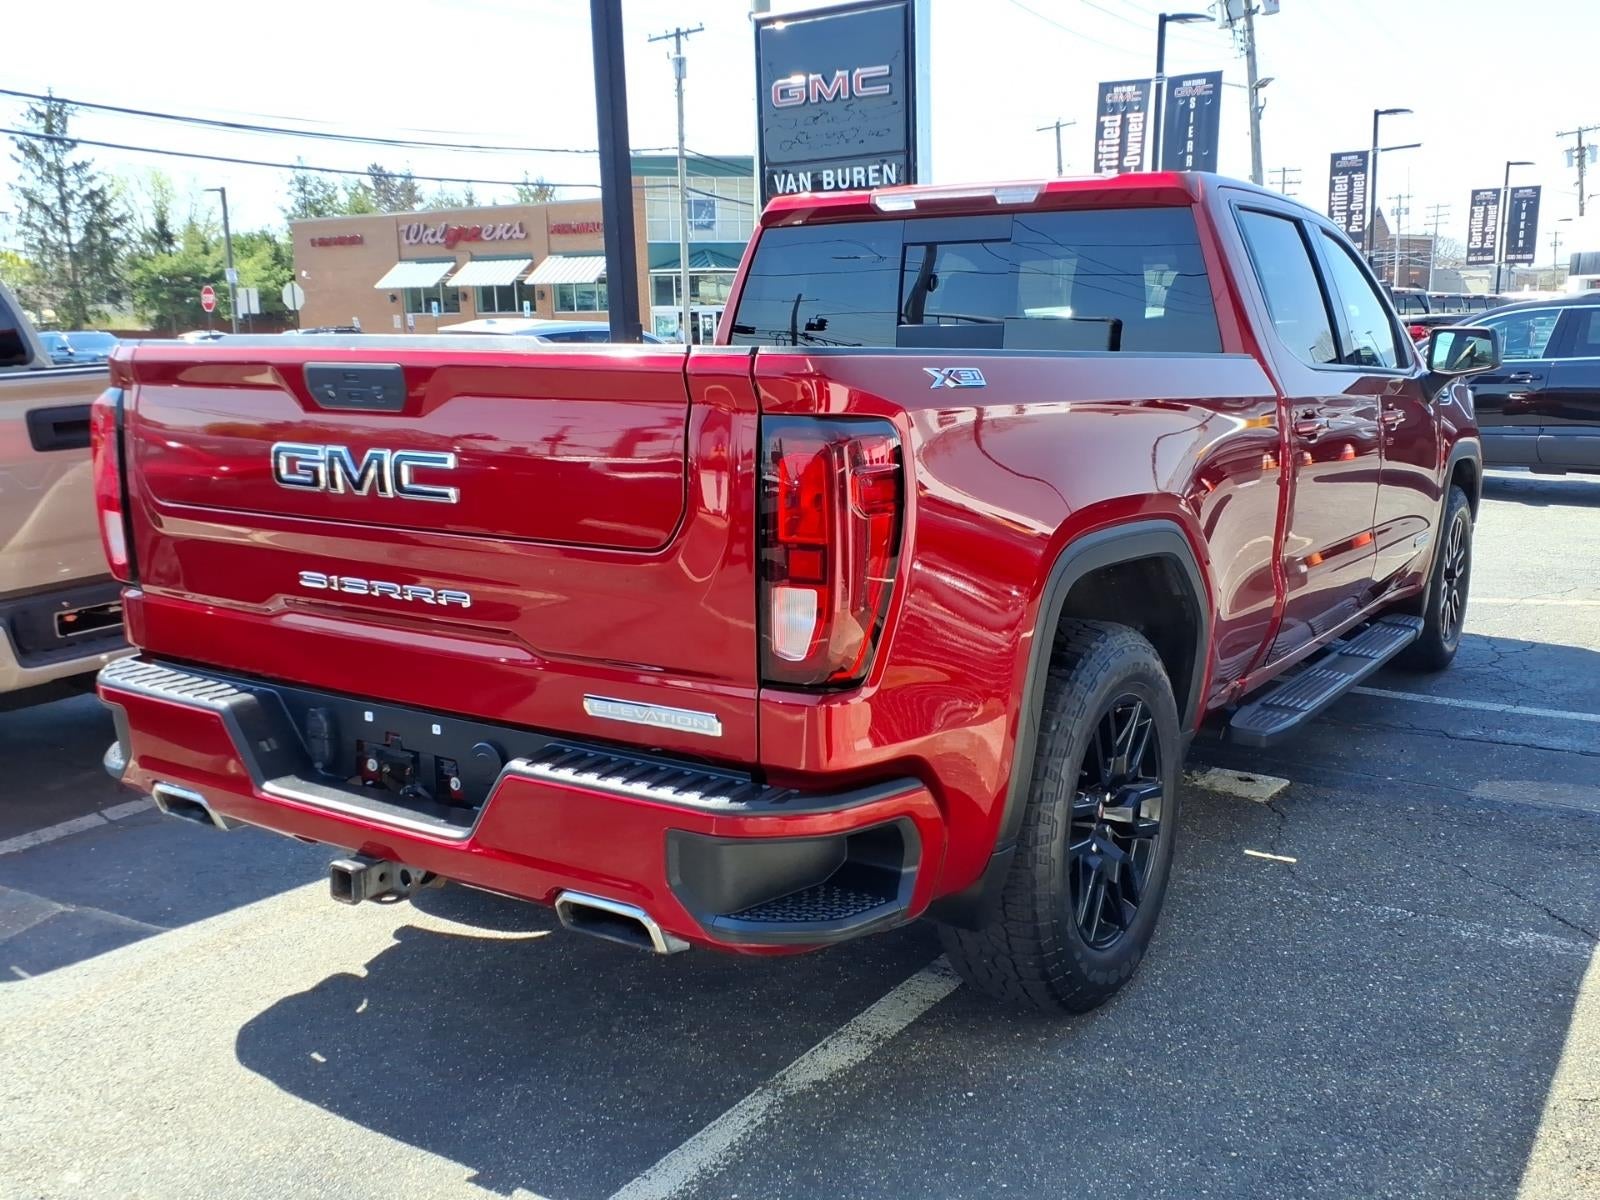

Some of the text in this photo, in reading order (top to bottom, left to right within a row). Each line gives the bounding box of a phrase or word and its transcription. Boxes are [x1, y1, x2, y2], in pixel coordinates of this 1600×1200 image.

[771, 64, 890, 109] GMC
[1186, 97, 1196, 173] SIERR
[774, 163, 897, 194] VAN BUREN
[1349, 173, 1366, 233] Pre-Owned
[400, 220, 527, 249] Walgreens
[1469, 206, 1485, 249] Certified
[1483, 204, 1498, 248] Pre-Owned
[271, 441, 459, 504] GMC
[298, 570, 472, 609] SIERRA
[592, 702, 709, 730] ELEVATION
